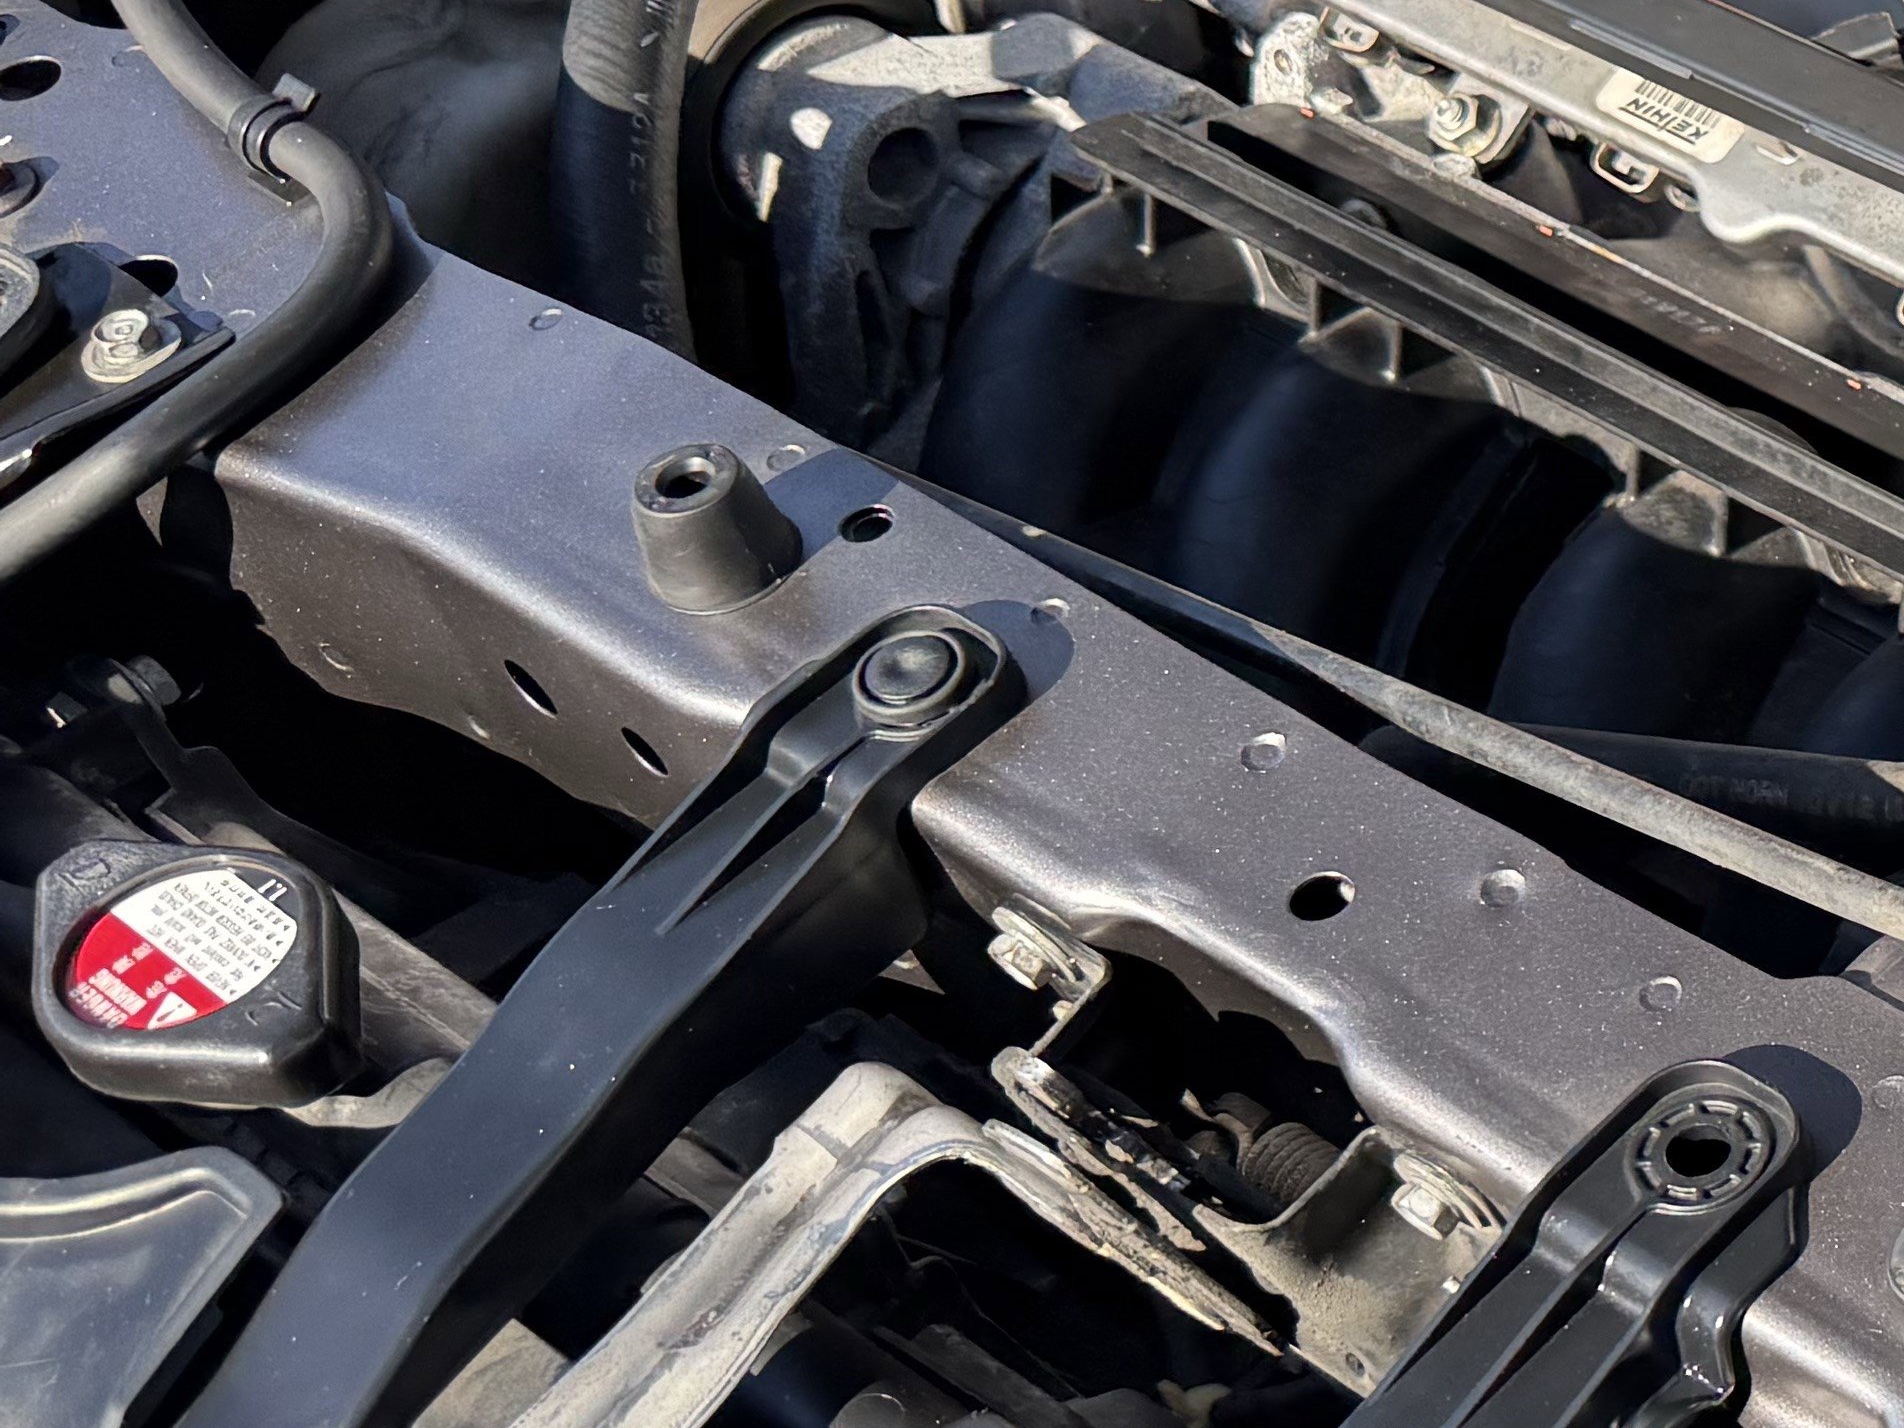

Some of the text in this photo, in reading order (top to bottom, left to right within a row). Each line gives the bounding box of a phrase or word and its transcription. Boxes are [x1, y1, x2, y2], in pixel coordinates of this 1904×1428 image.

[1627, 97, 1708, 140] KEIHIN
[68, 981, 128, 1029] DANGER
[89, 968, 147, 1016] WARNING
